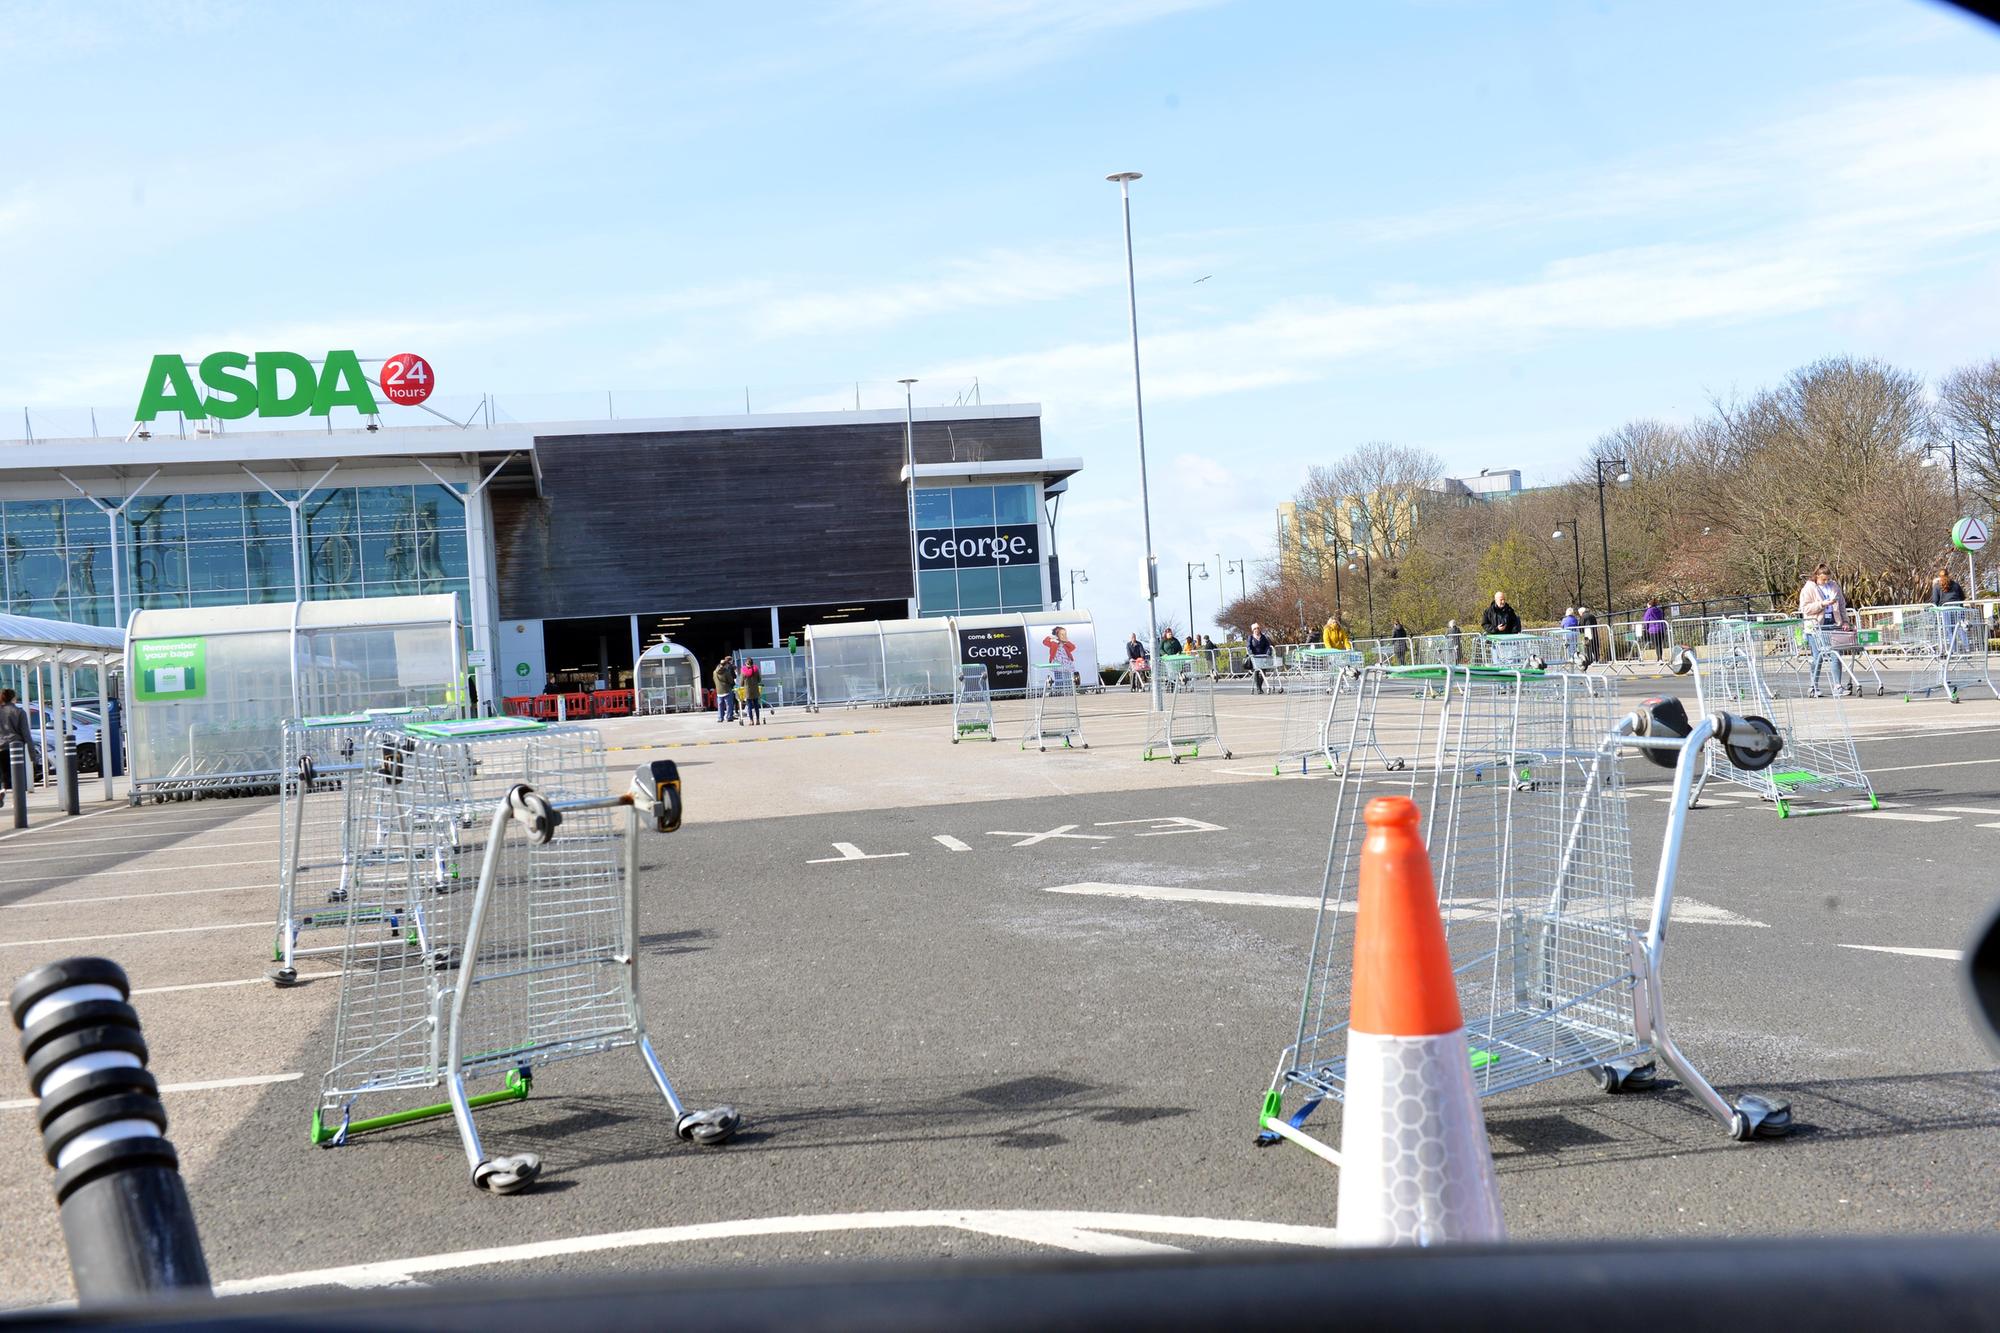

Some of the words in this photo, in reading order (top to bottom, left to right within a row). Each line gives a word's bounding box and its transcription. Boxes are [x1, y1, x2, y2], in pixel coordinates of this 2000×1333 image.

[386, 361, 427, 385] 24
[135, 350, 379, 421] ASDA
[389, 387, 426, 398] hours
[143, 643, 198, 651] Remember
[145, 652, 168, 660] your
[169, 650, 194, 658] bags
[806, 816, 1228, 863] EXIT
